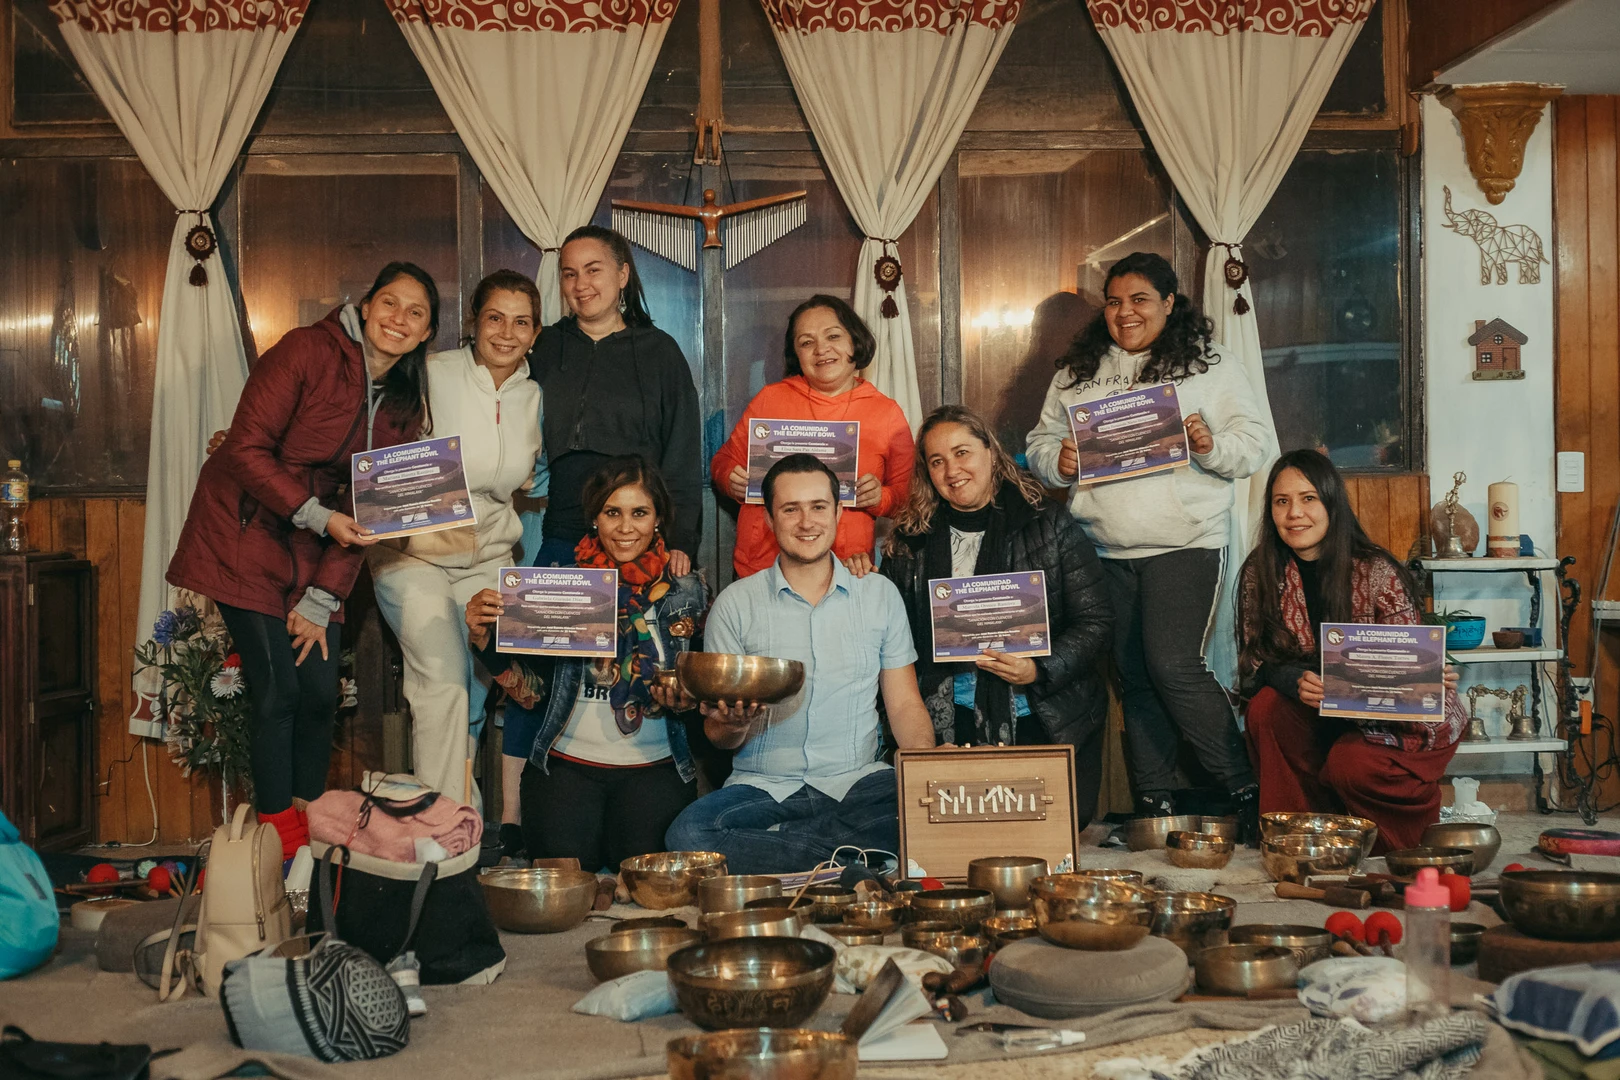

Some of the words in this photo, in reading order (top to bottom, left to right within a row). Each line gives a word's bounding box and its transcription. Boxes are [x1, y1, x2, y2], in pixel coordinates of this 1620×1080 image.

[1076, 378, 1101, 395] SAN
[1093, 409, 1106, 417] THE
[1106, 402, 1136, 415] ELEPHANT
[1136, 397, 1156, 407] BOWL
[1108, 393, 1147, 408] COMUNIDAD
[389, 453, 419, 465] ELEPHANT
[420, 450, 439, 459] BOWL
[392, 445, 430, 458] COMUNIDAD
[968, 585, 1000, 594] ELEPHANT
[1001, 583, 1020, 591] BOWL
[971, 578, 1012, 588] COMUNIDAD
